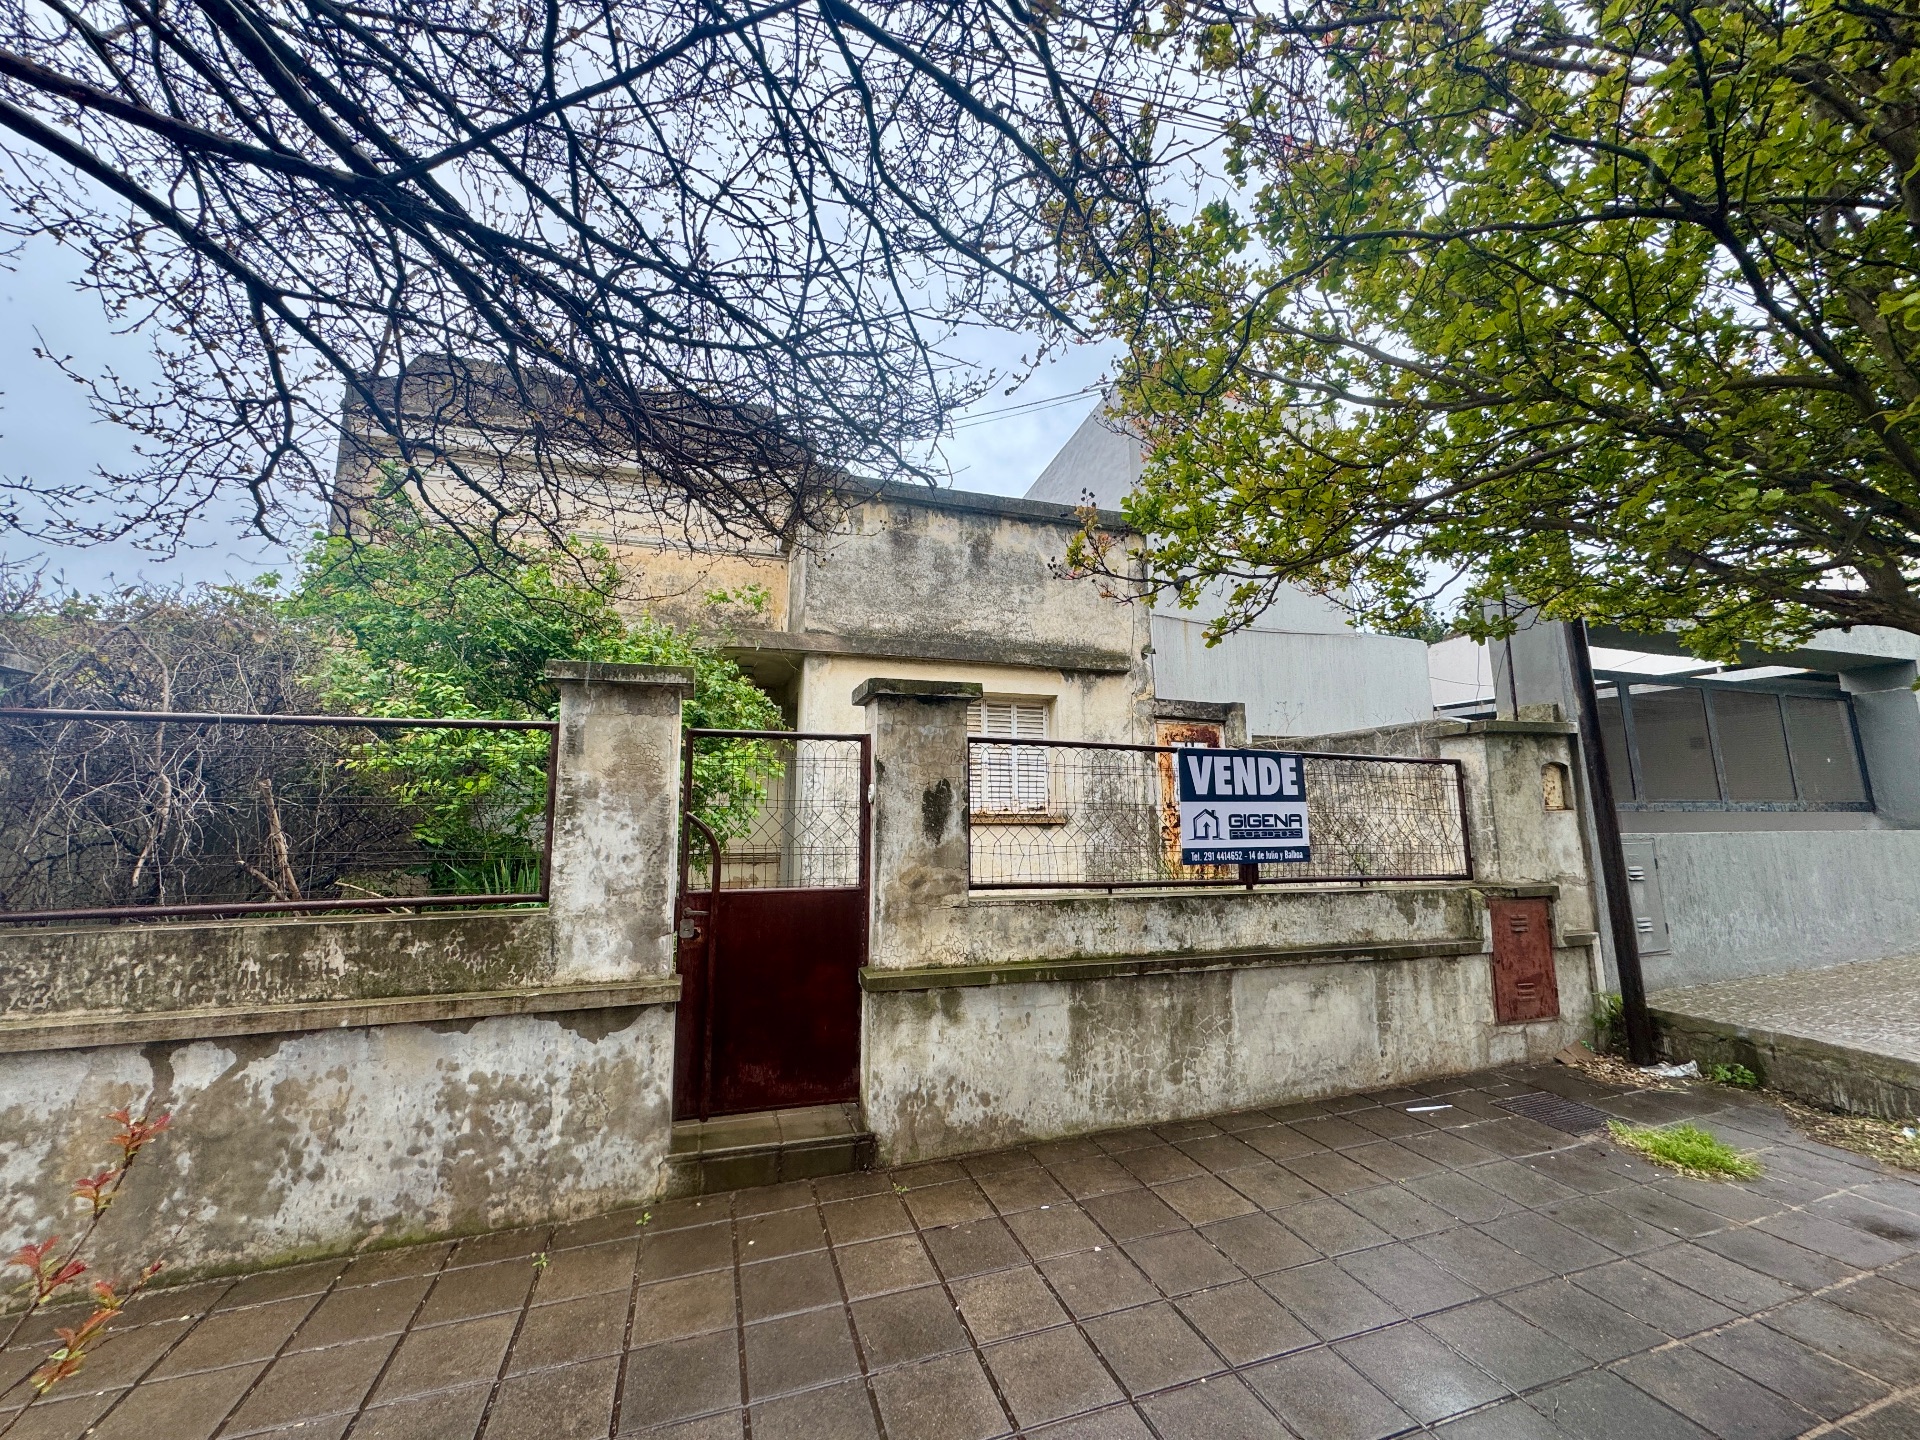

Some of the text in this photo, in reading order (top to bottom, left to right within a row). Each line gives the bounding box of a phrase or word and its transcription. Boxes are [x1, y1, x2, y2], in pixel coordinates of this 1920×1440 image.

[1187, 756, 1299, 795] VENDE
[1228, 814, 1302, 828] GIGENA
[1191, 852, 1202, 861] Tel.
[1204, 851, 1215, 861] 291
[1217, 851, 1243, 860] 4414652
[1249, 850, 1255, 860] 14
[1257, 851, 1264, 859] de
[1279, 852, 1283, 861] y
